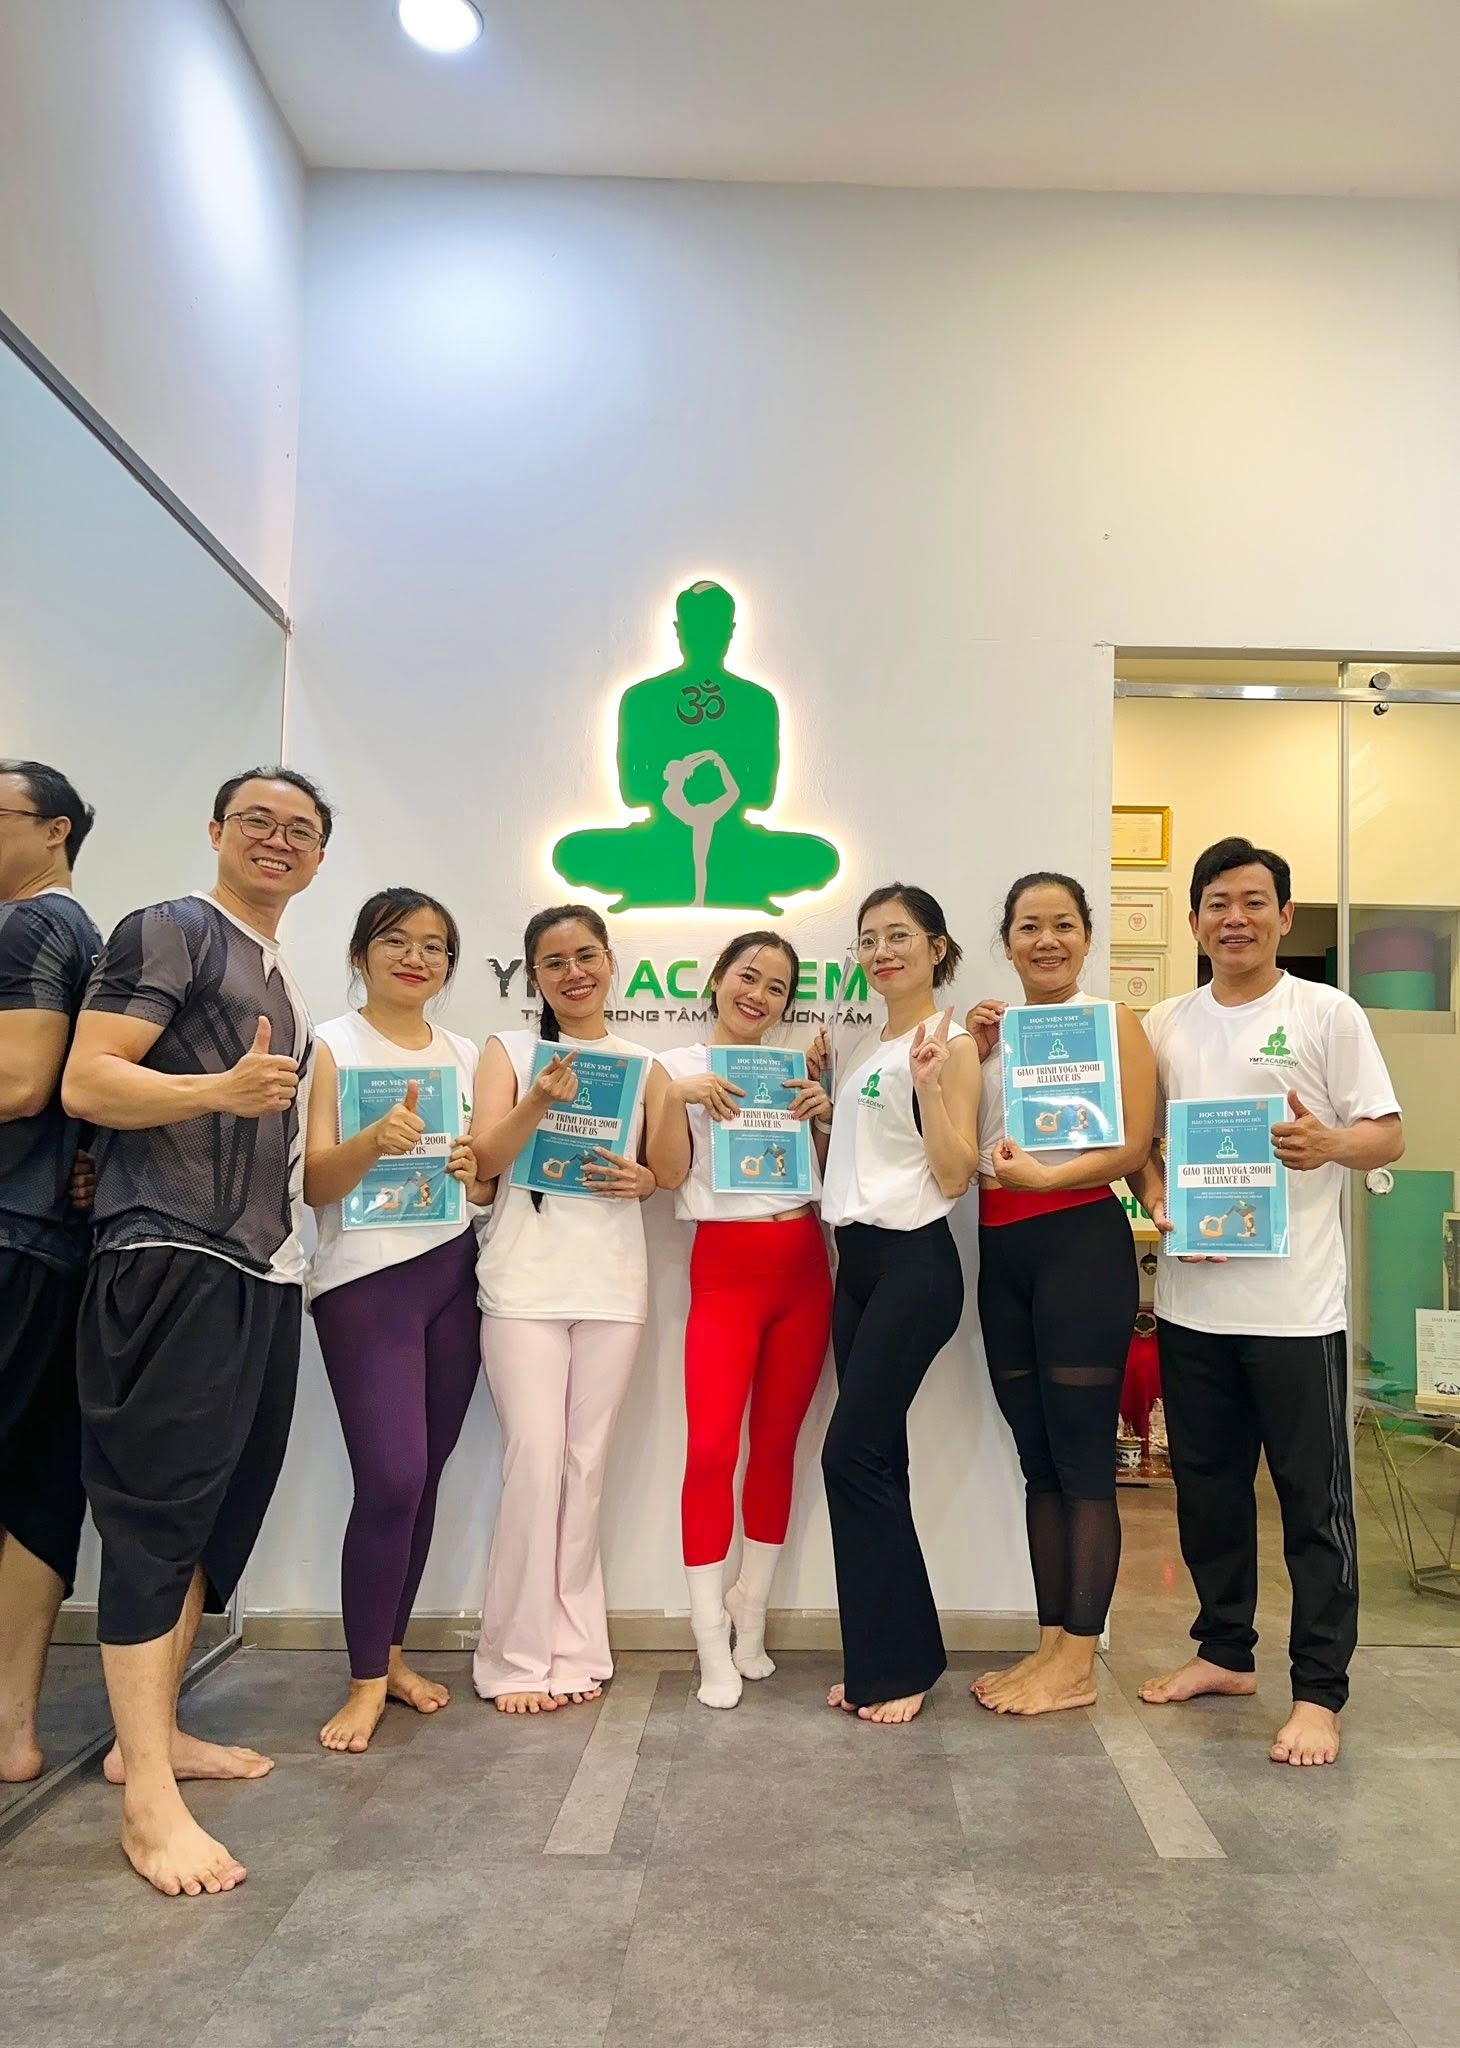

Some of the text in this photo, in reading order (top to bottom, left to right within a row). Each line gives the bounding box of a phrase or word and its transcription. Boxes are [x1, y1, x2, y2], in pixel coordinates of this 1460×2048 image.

[665, 1006, 707, 1022] TÂM
[1059, 1064, 1078, 1074] YOGA
[1080, 1063, 1100, 1073] 200H
[1264, 1058, 1298, 1068] ACADEMY
[1037, 1073, 1081, 1084] ALLIANCE US
[763, 1111, 779, 1120] YOGA
[579, 1116, 597, 1127] YOGA
[599, 1119, 618, 1129] 200H
[743, 1119, 782, 1129] ALLIANCE US
[555, 1123, 599, 1136] ALLIANCE US
[1227, 1165, 1247, 1175] YOGA
[1249, 1165, 1271, 1175] 200H
[1203, 1174, 1251, 1185] ALLIANCE US
